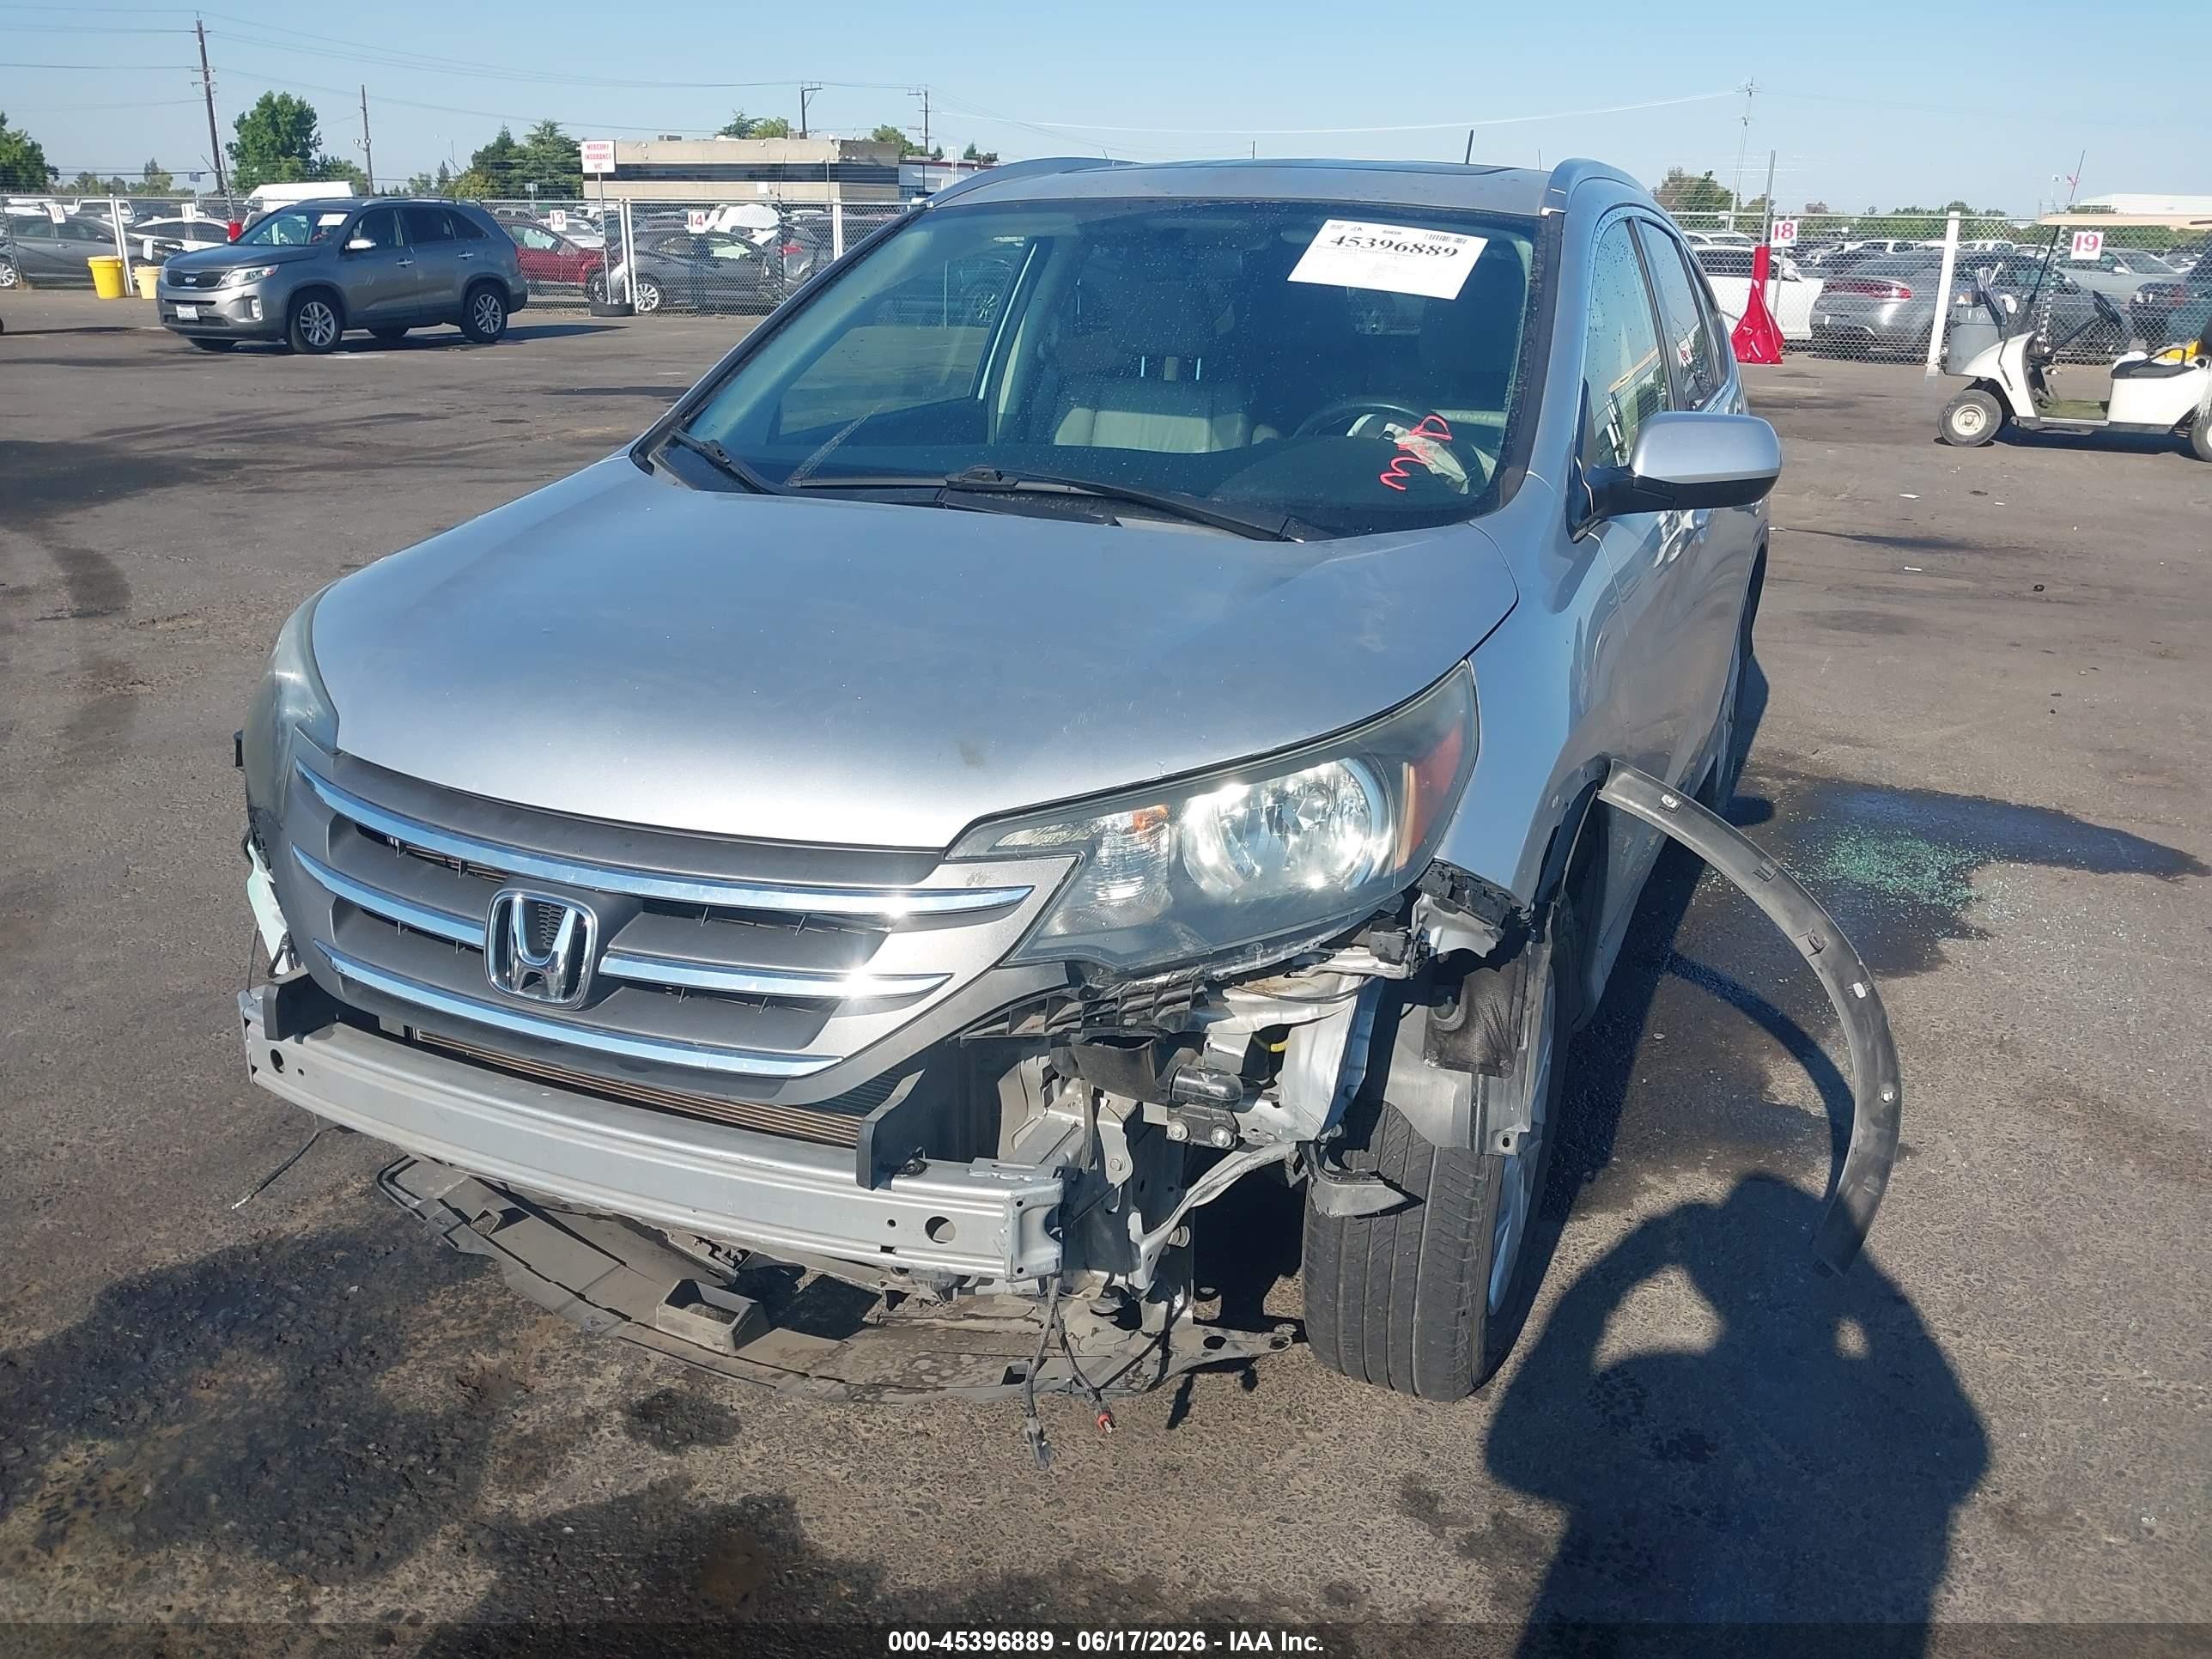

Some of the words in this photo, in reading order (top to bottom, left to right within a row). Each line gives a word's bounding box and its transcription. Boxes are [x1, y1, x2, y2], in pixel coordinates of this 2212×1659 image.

[551, 211, 564, 225] 13
[690, 214, 703, 228] 14
[1773, 222, 1795, 240] 18
[1329, 234, 1458, 258] 45396889
[2074, 234, 2098, 253] 19
